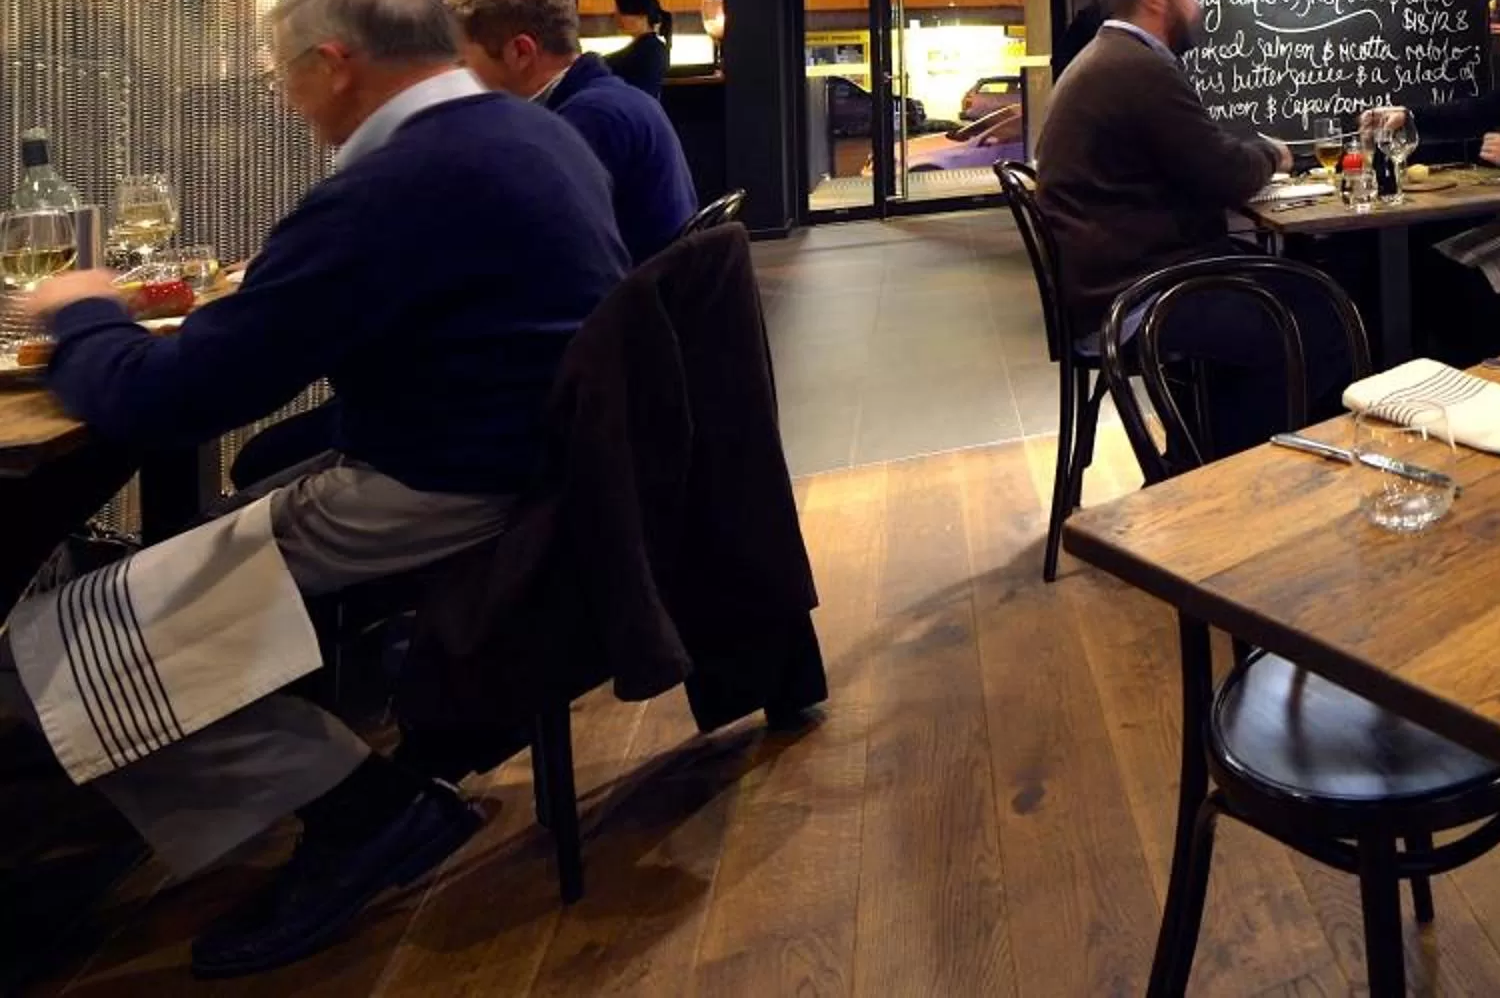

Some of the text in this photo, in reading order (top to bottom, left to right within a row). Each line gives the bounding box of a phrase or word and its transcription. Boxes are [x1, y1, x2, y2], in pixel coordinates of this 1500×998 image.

[1182, 29, 1253, 74] moked
[1252, 35, 1323, 71] salmon
[1392, 61, 1457, 93] salad
